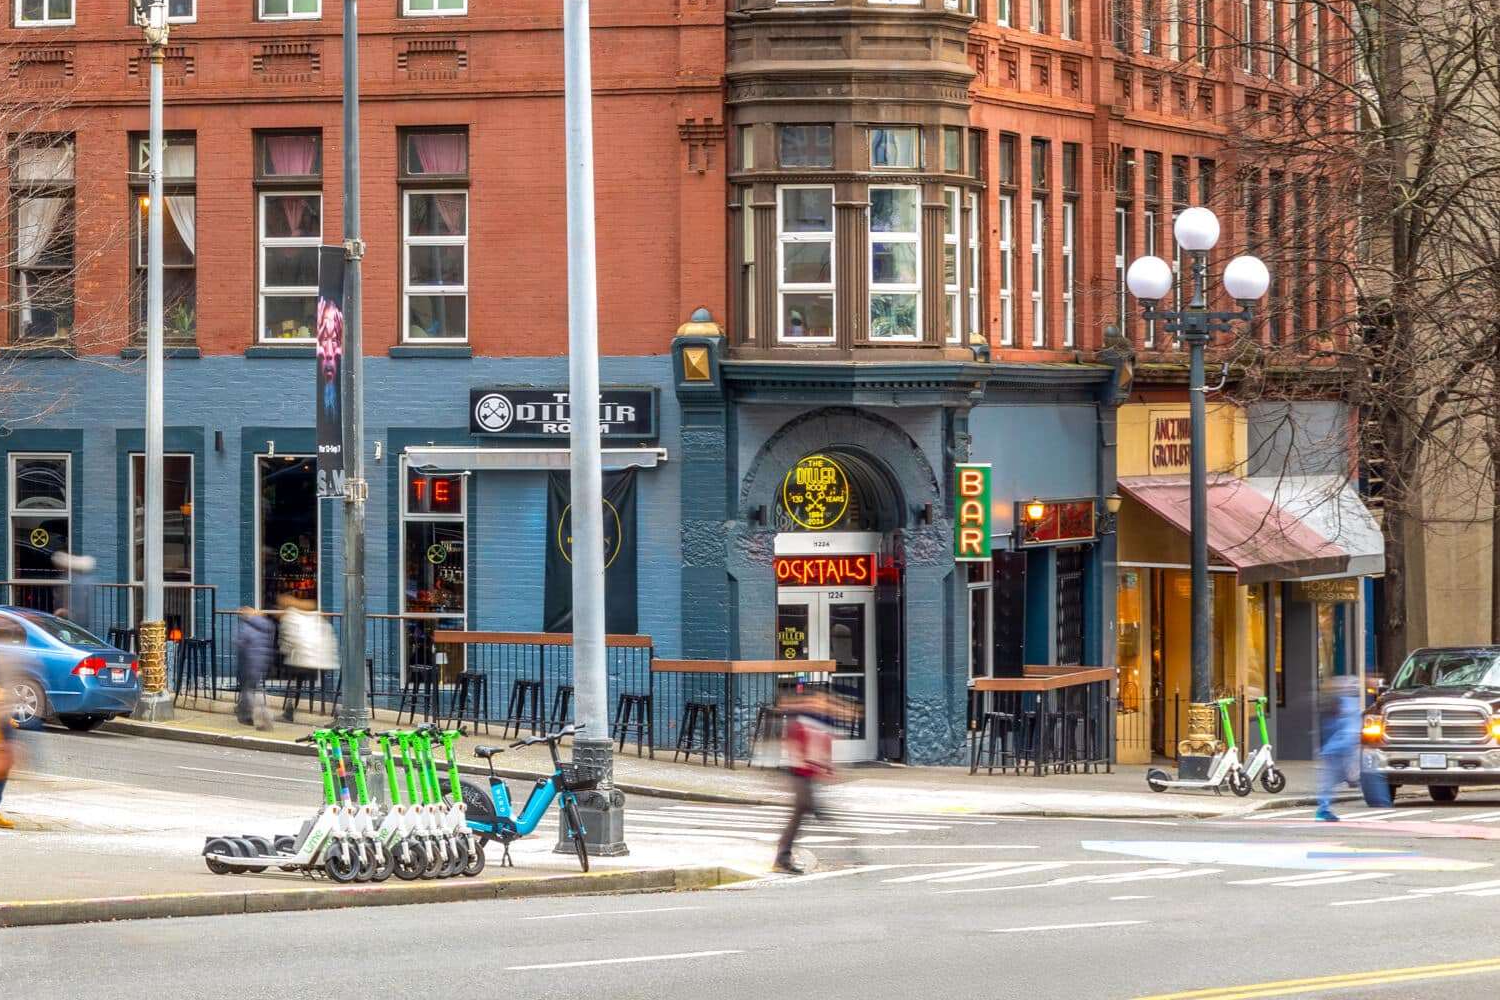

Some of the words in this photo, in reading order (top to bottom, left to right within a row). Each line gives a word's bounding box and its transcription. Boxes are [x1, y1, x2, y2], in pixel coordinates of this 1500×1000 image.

[516, 404, 636, 421] DILR
[543, 423, 610, 434] ROM
[807, 459, 825, 468] THE
[796, 467, 837, 485] DILLER
[960, 469, 983, 554] BAR
[776, 557, 868, 585] OCKTAILS
[827, 591, 844, 600] 1224
